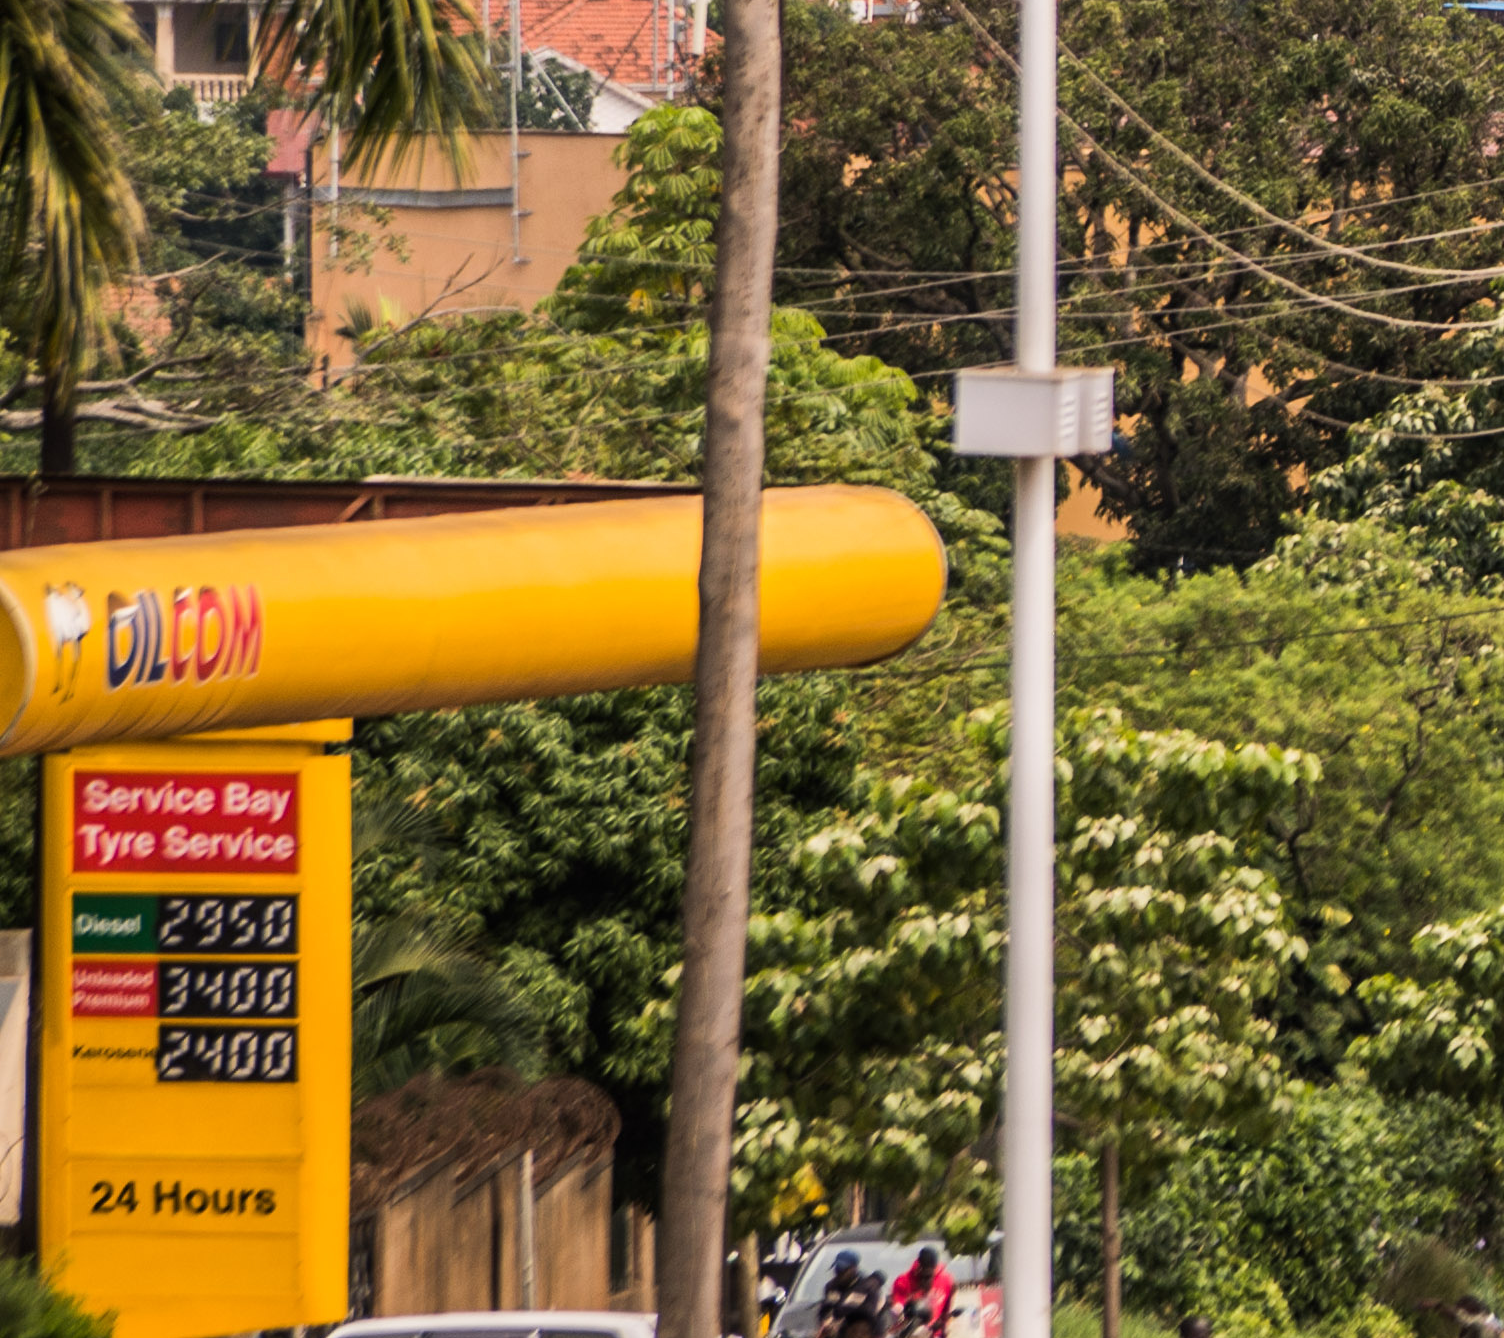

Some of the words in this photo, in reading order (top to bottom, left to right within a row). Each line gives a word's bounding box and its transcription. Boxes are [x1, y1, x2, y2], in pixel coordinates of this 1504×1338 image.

[106, 583, 262, 693] OILCOM
[82, 779, 216, 815] Service
[222, 781, 292, 824] Bay
[77, 823, 156, 866] Tyre
[162, 825, 295, 861] Service
[74, 913, 142, 938] Diesel
[159, 899, 293, 948] 2950
[72, 990, 151, 1011] Premium
[73, 969, 155, 989] Unleaded
[162, 967, 293, 1014] 3400
[159, 1031, 293, 1079] 2400
[90, 1180, 139, 1216] 24
[152, 1180, 277, 1216] Hours
